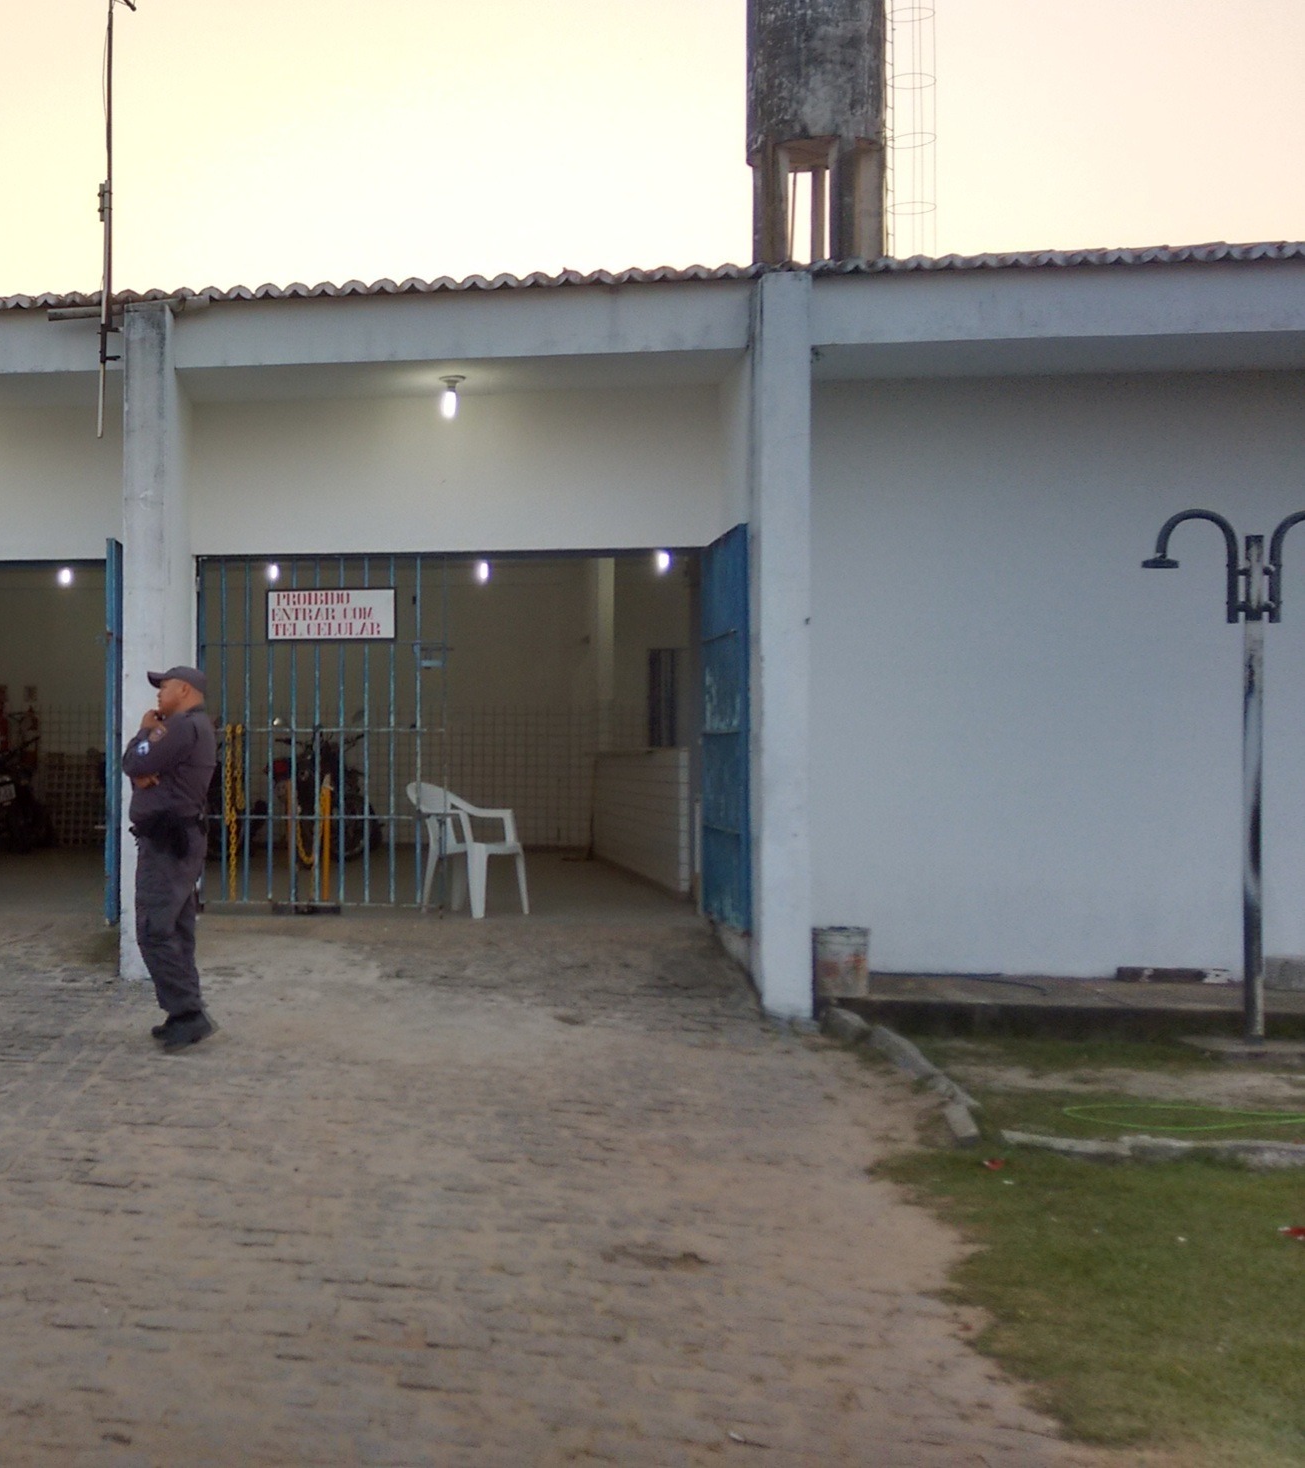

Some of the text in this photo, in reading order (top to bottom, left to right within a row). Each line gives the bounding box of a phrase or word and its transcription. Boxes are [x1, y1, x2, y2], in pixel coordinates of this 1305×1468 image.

[276, 592, 350, 606] PROIBIDO
[271, 606, 374, 621] ENTRAR COM
[306, 622, 381, 636] CELULAR
